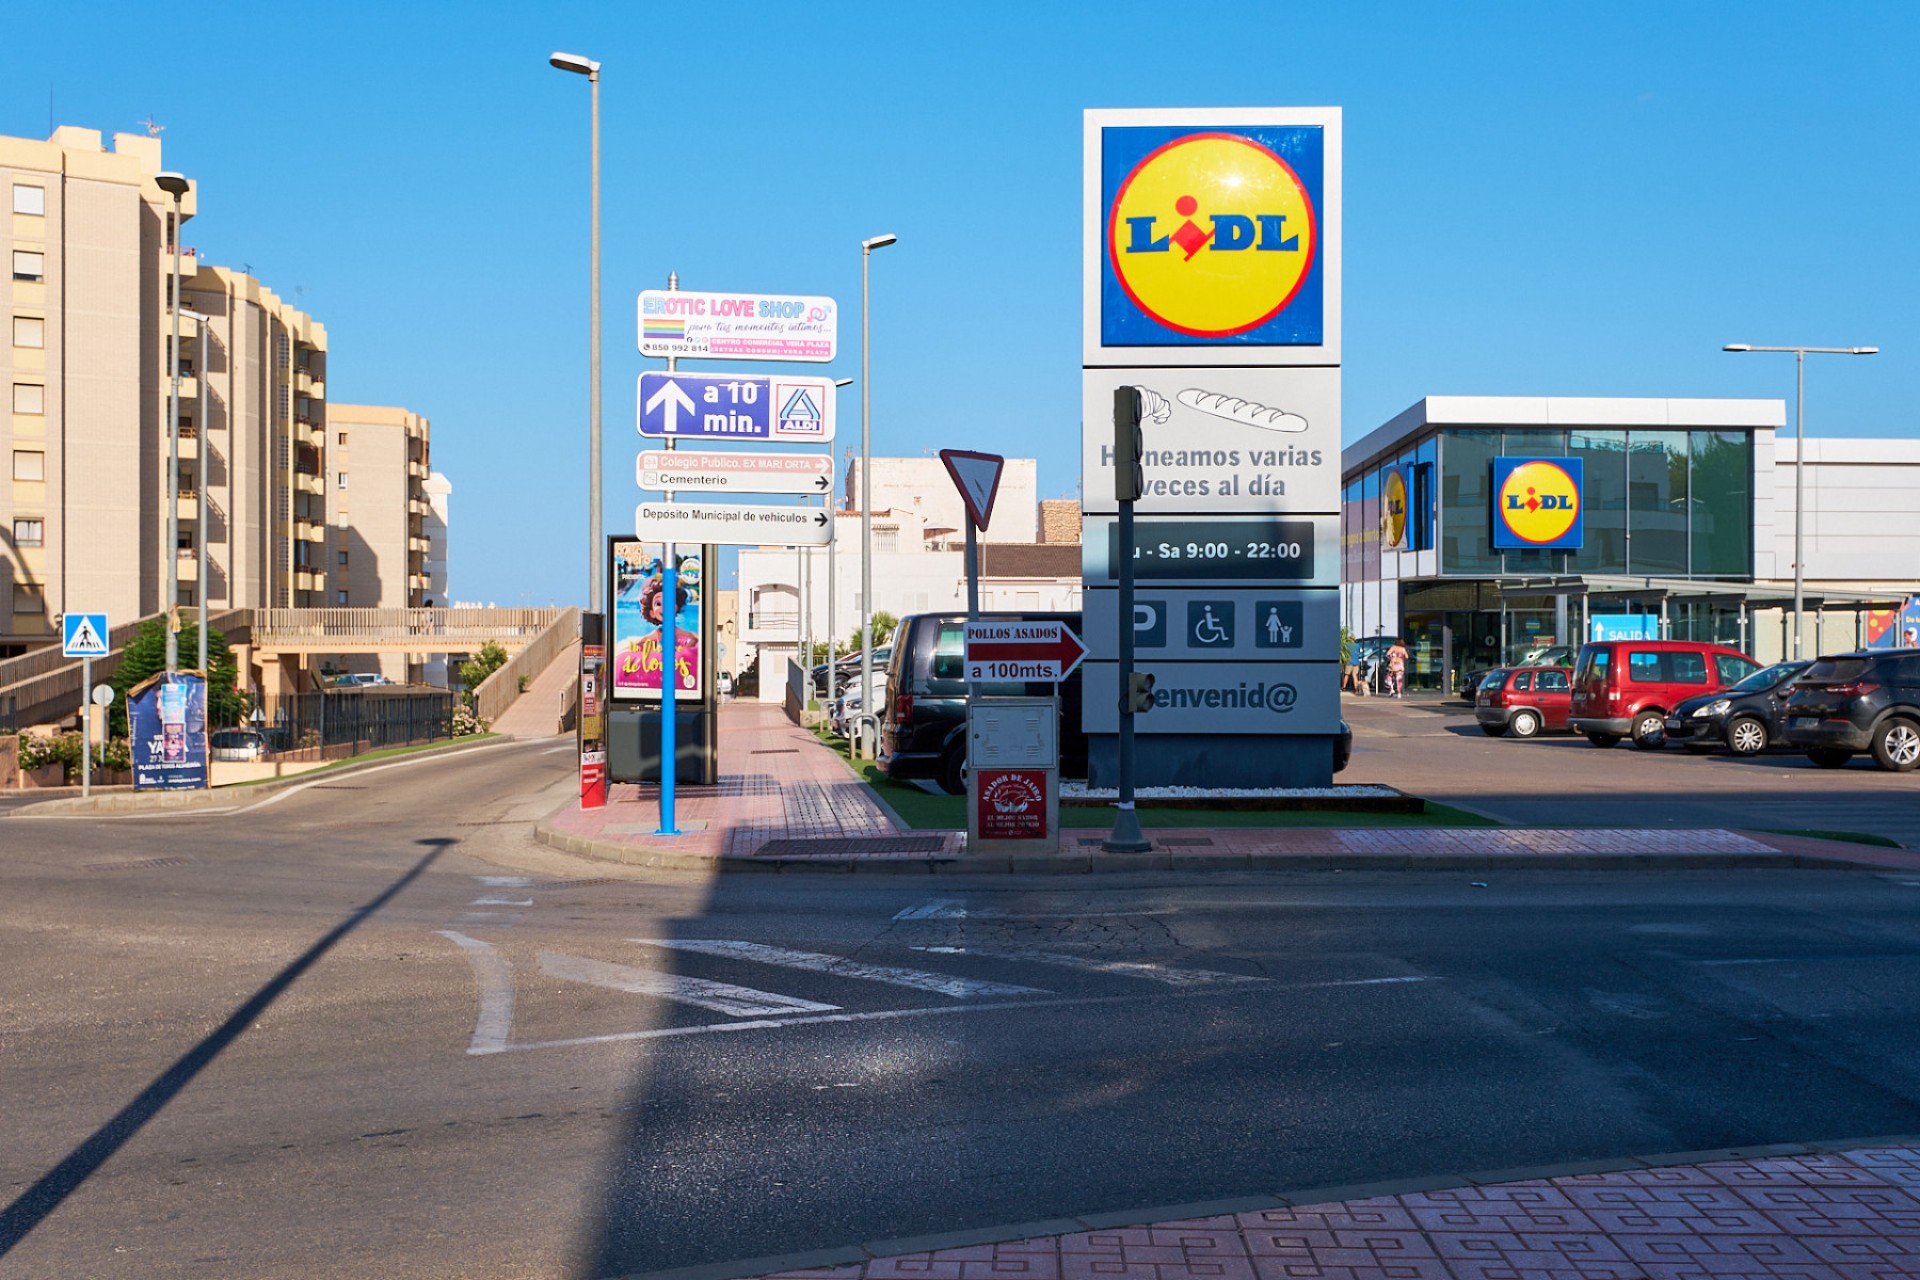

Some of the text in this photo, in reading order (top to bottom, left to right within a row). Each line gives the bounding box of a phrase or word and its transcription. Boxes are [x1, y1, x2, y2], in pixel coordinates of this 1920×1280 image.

[643, 297, 805, 319] EROTIC LOVE SHOP
[672, 344, 689, 352] 992
[742, 339, 784, 347] COMERCIAL
[703, 382, 758, 404] a 10
[704, 410, 762, 433] min.
[783, 420, 817, 431] ALDI
[660, 456, 699, 469] Colegio
[743, 459, 756, 468] EX
[758, 459, 783, 469] MARI
[1101, 445, 1323, 467] Hneamos varias
[660, 474, 727, 485] Cementerio
[1142, 474, 1285, 496] veces al día
[692, 510, 740, 522] Municipal
[743, 512, 756, 521] de
[1158, 543, 1180, 559] Sa
[1186, 543, 1229, 559] 9:00
[1246, 542, 1300, 559] 22:00
[967, 626, 1058, 640] POLLOS ASADOS
[1608, 630, 1652, 641] SALIDA
[971, 663, 1058, 678] a 100mts.
[1153, 682, 1298, 713] envenid@
[982, 774, 1009, 802] ASADOR
[1010, 773, 1023, 783] DE
